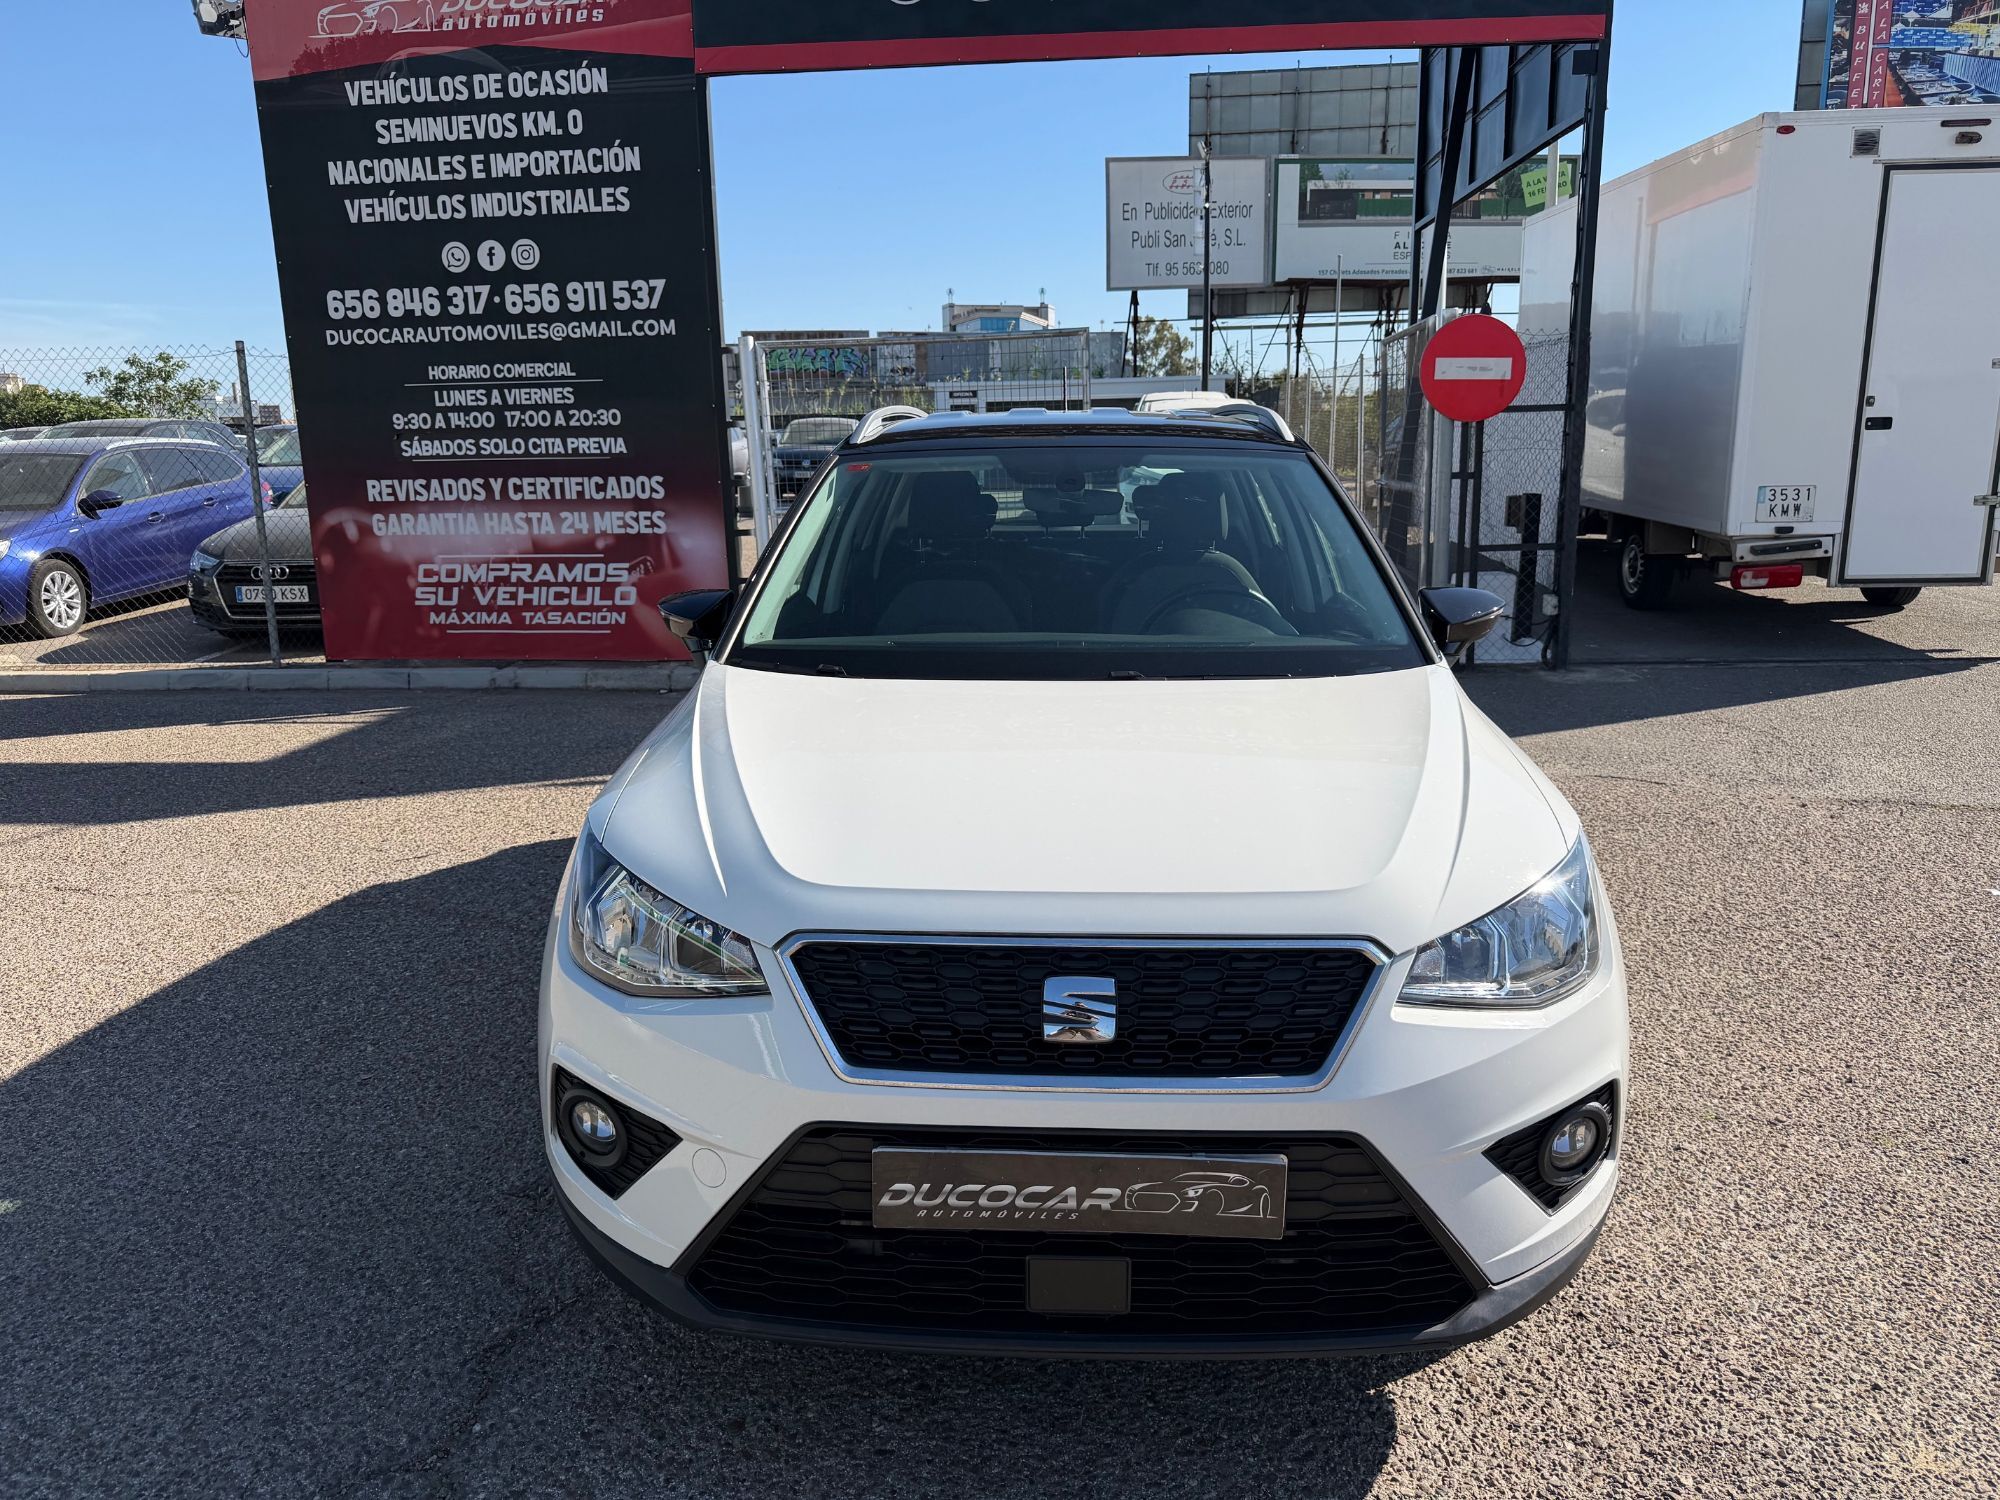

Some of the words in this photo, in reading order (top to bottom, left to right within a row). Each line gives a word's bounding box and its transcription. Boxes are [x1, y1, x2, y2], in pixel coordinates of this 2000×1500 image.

[442, 8, 604, 31] automóviles
[344, 72, 468, 106] VEHÍCULOS
[473, 74, 503, 100] DE
[508, 60, 608, 98] OCASIÓN
[375, 113, 517, 145] SEMINUEVOS
[522, 111, 563, 138] KM.
[328, 155, 467, 185] NACIONALES
[471, 154, 486, 179] E
[490, 139, 640, 178] IMPORTACIÓN
[344, 190, 466, 223] VEHÍCULOS
[471, 187, 630, 218] INDUSTRIALES
[1122, 202, 1138, 221] En
[1211, 200, 1253, 219] Exterior
[1132, 230, 1160, 249] Publi
[1163, 229, 1186, 248] San
[1224, 228, 1247, 247] S.L.
[1165, 261, 1179, 277] 95
[1182, 260, 1229, 277] 563080
[326, 289, 380, 320] 656
[387, 287, 440, 318] 846
[566, 281, 606, 312] 911
[613, 278, 666, 311] 537
[325, 318, 676, 346] DUCOCARAUTOMOVILES@GMAIL.COM
[429, 364, 490, 381] HORARIO
[493, 362, 576, 379] COMERCIAL
[435, 389, 488, 406] LUNES
[491, 388, 502, 405] A
[504, 387, 574, 405] VIERNES
[393, 413, 431, 430] 9:30
[435, 413, 446, 429] A
[448, 411, 495, 429] 14:00
[505, 410, 551, 428] 17:00
[555, 410, 566, 427] A
[569, 409, 621, 427] 20:30
[401, 436, 477, 458] SÁBADOS
[479, 438, 525, 456] SOLO
[528, 438, 565, 455] CITA
[567, 437, 627, 455] PREVIA
[367, 478, 486, 502] REVISADOS
[488, 478, 502, 501] Y
[508, 475, 665, 501] CERTIFICADOS
[1768, 488, 1811, 501] 3531
[1768, 503, 1802, 518] KMW
[372, 513, 479, 537] GARANTIA
[484, 512, 555, 536] HASTA
[560, 511, 590, 535] 24
[594, 511, 667, 535] MESES
[418, 563, 630, 584] COMPRAMOS
[280, 587, 306, 600] KSX
[415, 586, 459, 607] SU
[474, 586, 637, 607] VEHICULO
[429, 608, 512, 625] MÁXIMA
[522, 607, 626, 625] TASACIÓN
[877, 1182, 1122, 1211] DUCOCAR
[917, 1209, 1080, 1221] AUTOMÓVILES
